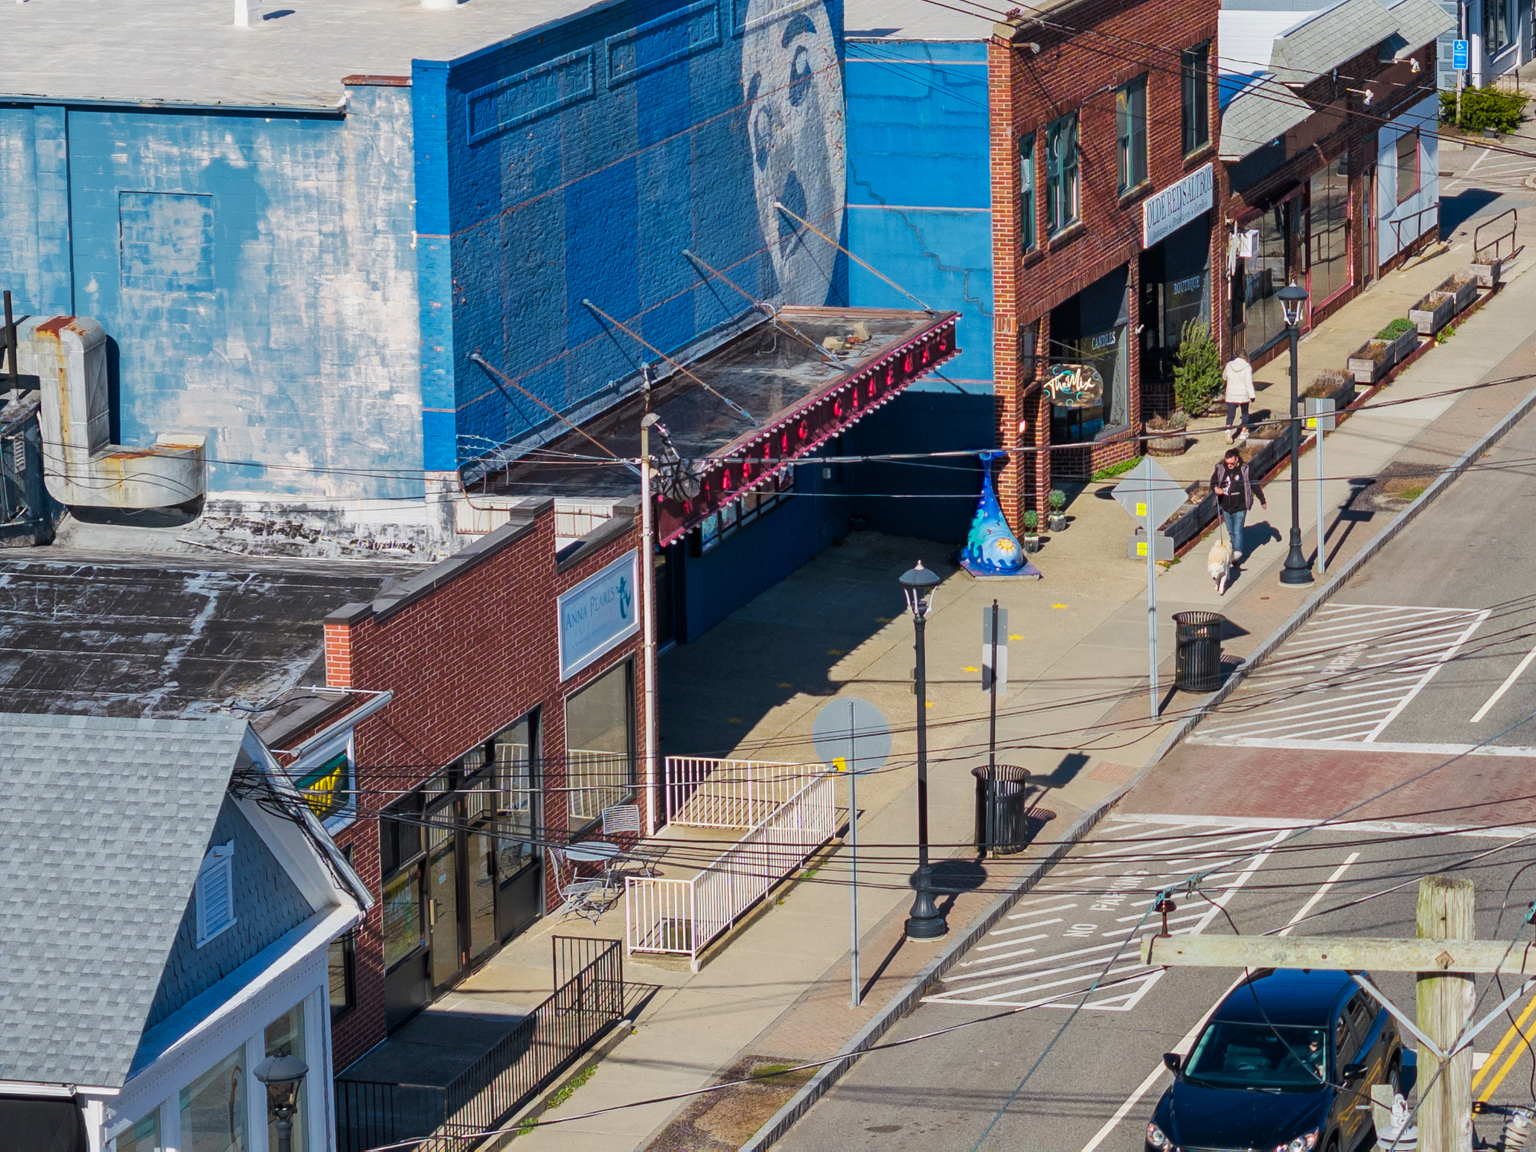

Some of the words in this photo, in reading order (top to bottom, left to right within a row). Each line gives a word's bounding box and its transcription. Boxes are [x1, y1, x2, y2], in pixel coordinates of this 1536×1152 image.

[1147, 195, 1167, 229] OLDE
[1167, 185, 1182, 217] RED
[1182, 166, 1213, 206] SALTBOX
[1173, 275, 1200, 296] BOUTIQUE
[1091, 330, 1116, 350] CANDLES
[833, 331, 947, 417] CINEMAS
[565, 605, 588, 631] ANNA
[1062, 923, 1098, 938] NO
[1089, 870, 1150, 911] PARKING
